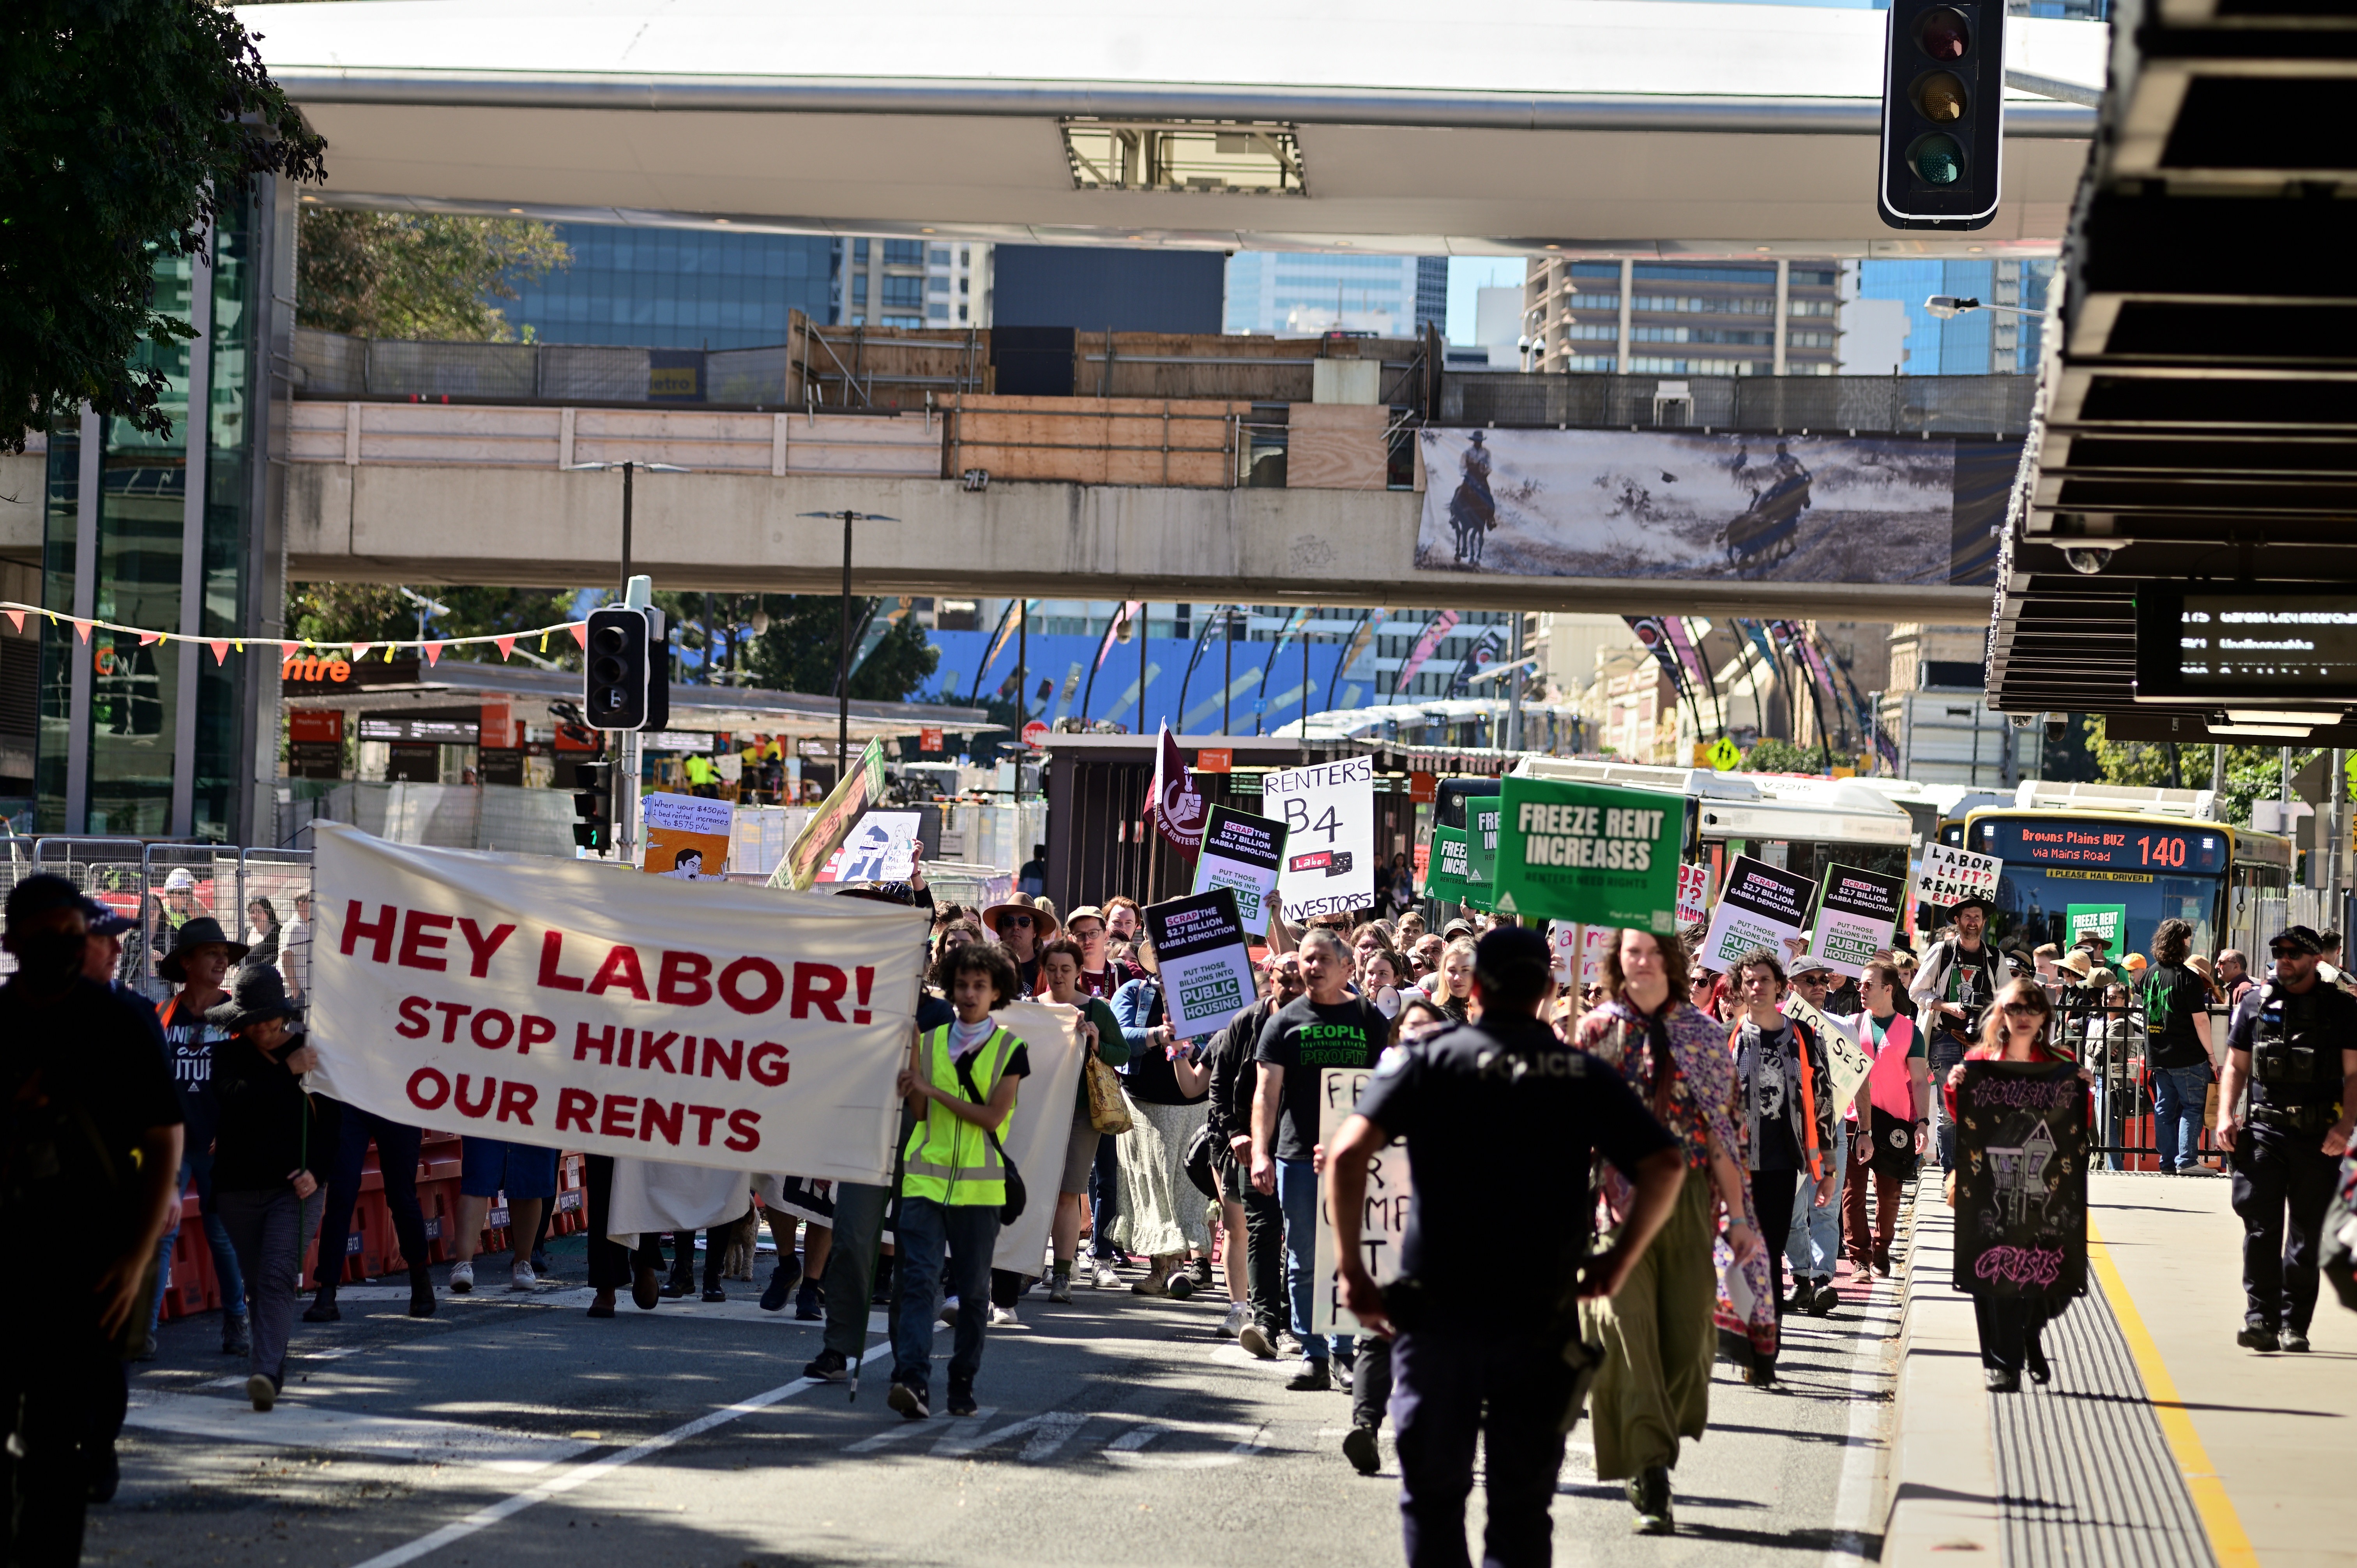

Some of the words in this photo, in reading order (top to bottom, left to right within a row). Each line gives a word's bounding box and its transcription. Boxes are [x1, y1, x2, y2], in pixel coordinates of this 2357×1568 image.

[650, 378, 689, 390] etro
[282, 655, 350, 682] ntre
[327, 719, 335, 735] 1
[1222, 754, 1228, 766] 1
[1265, 759, 1371, 796] RENTERS
[654, 799, 673, 809] When
[677, 803, 695, 814] your
[659, 810, 670, 818] bed
[696, 815, 729, 826] increases
[1478, 812, 1501, 831] FRE
[1518, 803, 1599, 837] FREEZE
[1605, 808, 1664, 840] RENT
[1160, 821, 1170, 831] OF
[1168, 829, 1200, 846] RENTERS
[1220, 831, 1238, 841] $2.7
[1239, 836, 1271, 850] BILLION
[1225, 823, 1253, 835] SCRAP
[1254, 830, 1270, 840] THE
[2022, 829, 2064, 843] Browns
[2067, 832, 2100, 845] Plains
[2103, 833, 2125, 846] BUZ
[861, 837, 889, 848] labour
[1210, 838, 1233, 849] GABBA
[1235, 844, 1277, 860] DEMOLITION
[1441, 841, 1466, 859] FREE
[2137, 836, 2186, 867] 140
[1525, 835, 1652, 871] INCREASES
[1932, 846, 1993, 872] LABOR
[2032, 848, 2048, 858] via
[2051, 848, 2080, 860] Mains
[2083, 850, 2110, 861] Road
[1296, 857, 1326, 869] Labor
[1212, 874, 1243, 887] BILLIONS
[1244, 883, 1260, 892] INTO
[1235, 872, 1257, 883] THOSE
[1440, 876, 1461, 885] RENTERS
[1462, 878, 1475, 886] NEED
[1525, 872, 1574, 885] RENTERS
[1576, 874, 1605, 887] NEED
[1607, 877, 1648, 889] RIGHTS
[1748, 874, 1777, 888] SCRAP
[1778, 884, 1795, 896] THE
[1938, 865, 1992, 887] LEFT?
[2055, 871, 2087, 879] PLEASE
[2112, 873, 2144, 882] DRIVER
[1742, 882, 1761, 893] $2.7
[1761, 888, 1795, 906] BILLION
[1839, 887, 1856, 896] $2.7
[1857, 891, 1888, 904] BILLION
[1843, 879, 1870, 890] SCRAP
[1872, 885, 1888, 895] THE
[1921, 877, 1993, 901] RENTERS
[1283, 892, 1371, 922] NVESTORS
[1730, 888, 1755, 901] GABBA
[1756, 897, 1801, 917] DEMOLITION
[1828, 893, 1852, 904] GABBA
[1853, 899, 1895, 913] DEMOLITION
[1932, 892, 1959, 905] BEH
[1167, 911, 1198, 925] SCRAP
[1199, 906, 1218, 917] THE
[1676, 903, 1704, 924] HIND
[2073, 913, 2098, 928] FREEZE
[2099, 911, 2118, 926] RENT
[1166, 926, 1185, 938] $2.7
[1187, 917, 1223, 933] BILLION
[1729, 925, 1761, 940] BILLIONS
[1762, 936, 1779, 946] INTO
[1737, 920, 1751, 929] PUT
[1753, 925, 1776, 938] THOSE
[1830, 927, 1860, 938] BILLIONS
[1852, 925, 1874, 934] THOSE
[1159, 936, 1187, 950] GABBA
[1187, 925, 1236, 943] DEMOLITION
[1827, 936, 1875, 955] PUBLIC
[340, 899, 517, 978] HEY
[538, 929, 875, 1025] LABOR!
[1183, 968, 1198, 977] PUT
[1200, 961, 1226, 973] THOSE
[1179, 973, 1214, 987] BILLIONS
[1216, 969, 1234, 978] INTO
[1182, 980, 1237, 1004] PUBLIC
[1186, 998, 1240, 1019] HOUSING
[395, 996, 556, 1054] STOP
[574, 1022, 790, 1087] HIKING
[1300, 1025, 1366, 1042] PEOPLE
[1301, 1049, 1368, 1065] PROFIT
[1970, 1076, 2079, 1109] HOUSING
[406, 1067, 538, 1125] OUR
[555, 1088, 761, 1152] RENTS
[560, 1195, 569, 1209] 1800
[491, 1212, 500, 1225] 1800
[1975, 1243, 2064, 1291] CRISIS
